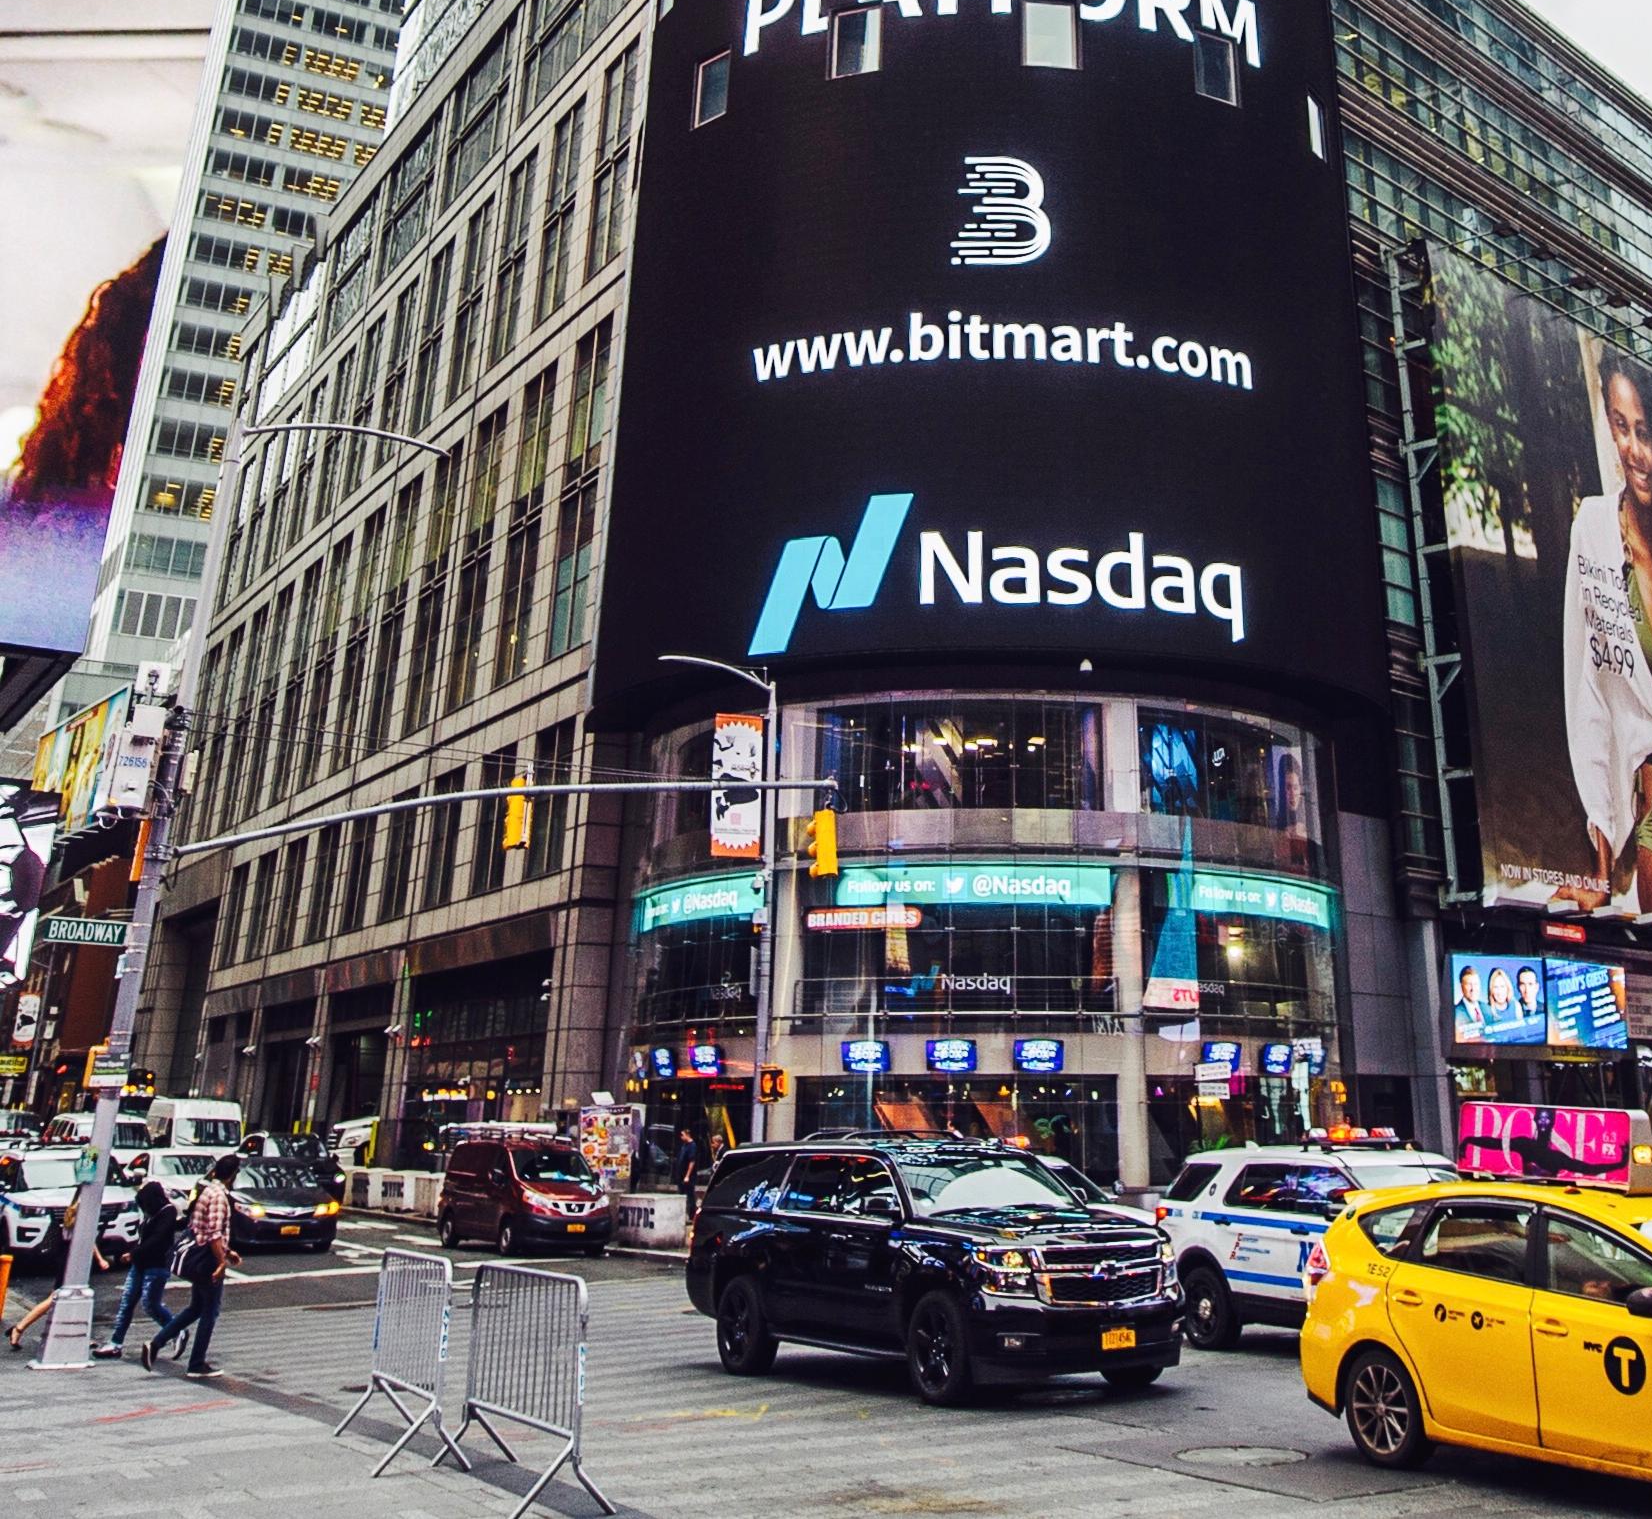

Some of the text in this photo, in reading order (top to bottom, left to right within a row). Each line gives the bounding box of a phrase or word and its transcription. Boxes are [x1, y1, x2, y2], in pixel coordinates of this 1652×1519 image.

[752, 310, 1254, 390] www.bitmart.com
[1578, 554, 1607, 584] Bikini
[918, 530, 1245, 643] Nasdaq
[1580, 581, 1642, 622] in Recycled
[1585, 607, 1634, 644] Materials
[1590, 634, 1635, 678] $4.99
[848, 879, 935, 893] Follow us on:
[972, 874, 1071, 899] @Nasdaq
[1500, 863, 1611, 893] NOW IN STORES AND ONLINE
[48, 919, 123, 942] BROADWAY
[807, 909, 868, 927] BRANDED
[941, 973, 1011, 994] Nasdaq
[1199, 982, 1225, 997] asdaq
[1470, 1105, 1607, 1177] POSE
[1602, 1143, 1617, 1156] FX
[1367, 1263, 1391, 1277] 1E52
[440, 1309, 451, 1359] NYPD
[1583, 1341, 1637, 1388] NYC T
